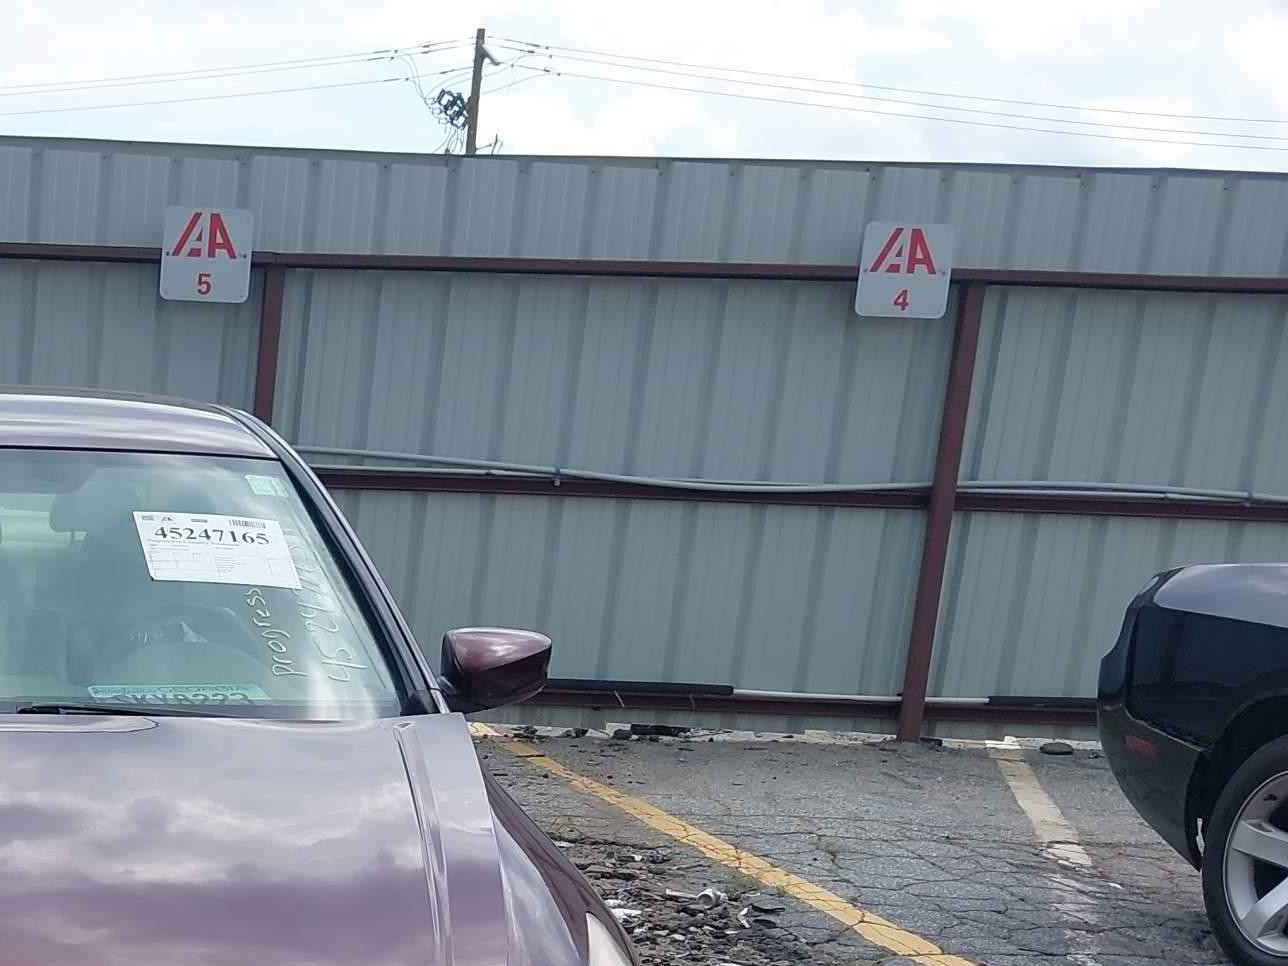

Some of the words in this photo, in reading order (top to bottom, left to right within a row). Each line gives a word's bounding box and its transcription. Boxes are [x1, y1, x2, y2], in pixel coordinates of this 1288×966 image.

[197, 273, 212, 294] 5
[893, 289, 909, 311] 4
[154, 526, 270, 545] 45247165
